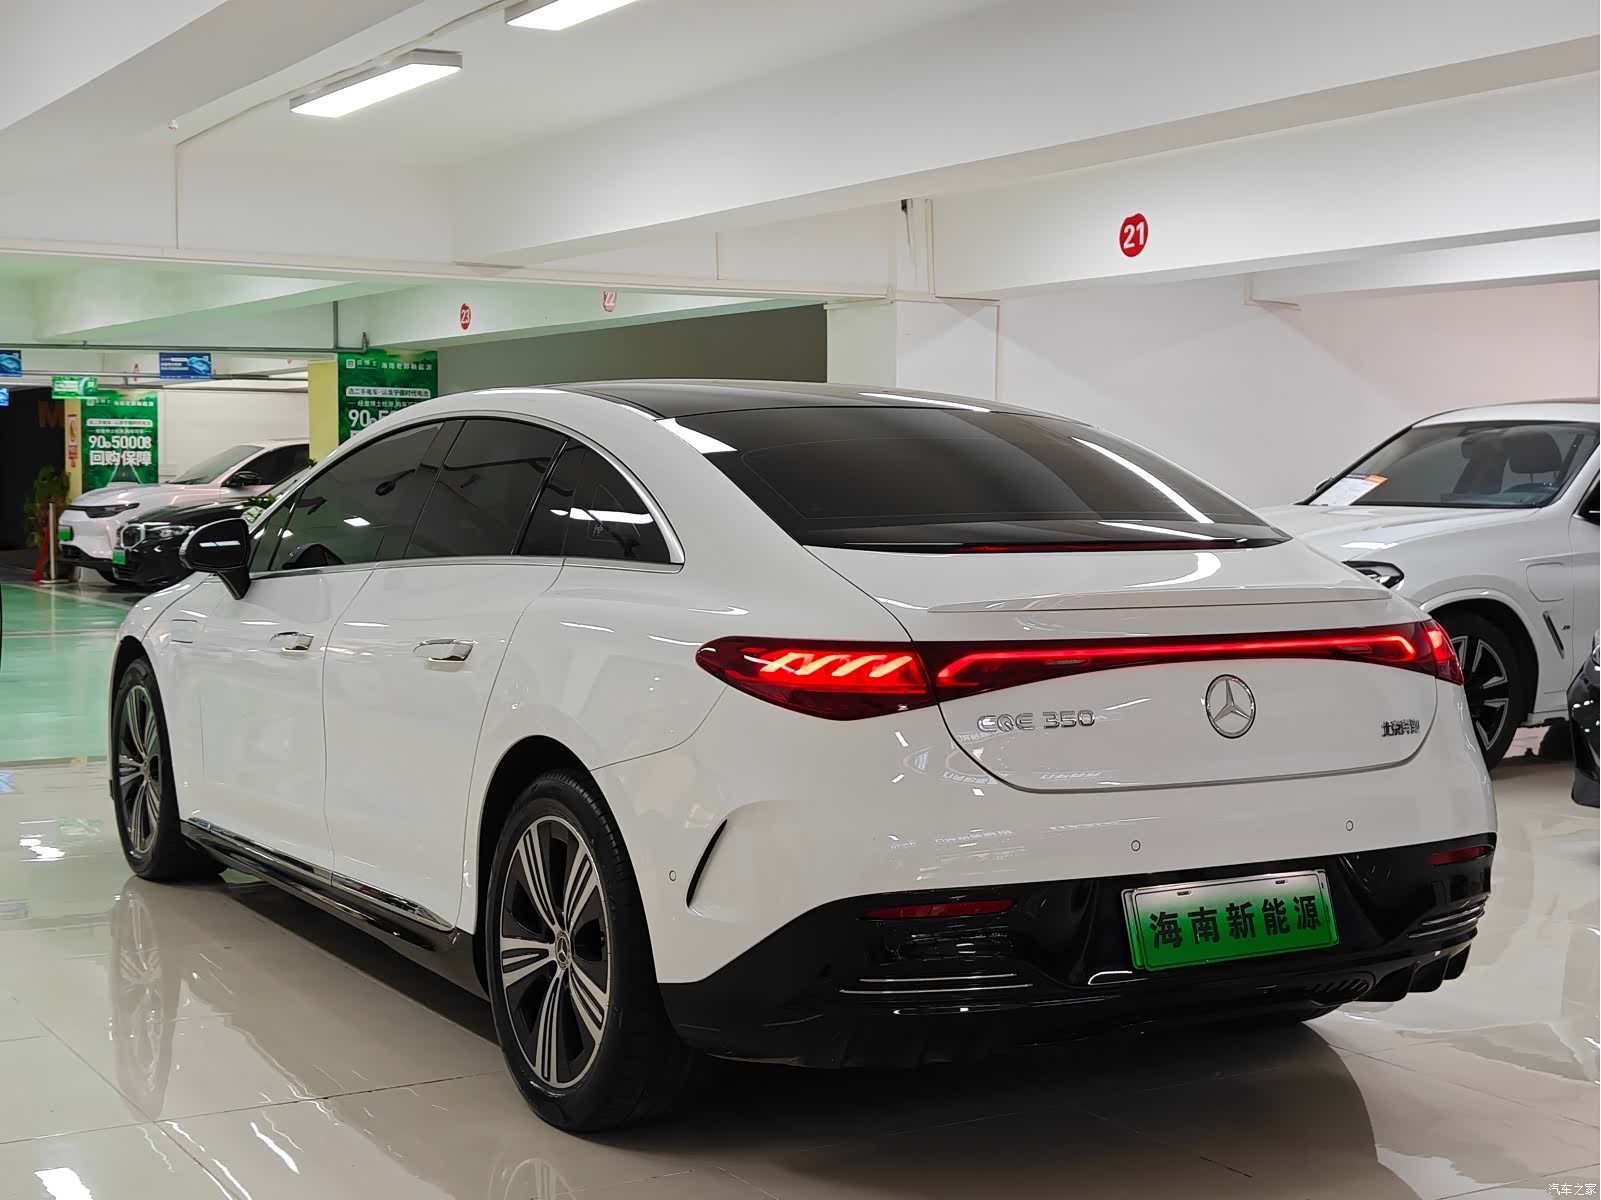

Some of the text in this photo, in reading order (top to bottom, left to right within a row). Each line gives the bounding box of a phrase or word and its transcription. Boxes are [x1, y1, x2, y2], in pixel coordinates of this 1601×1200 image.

[1123, 221, 1145, 249] 21
[605, 290, 616, 306] 22
[460, 308, 471, 324] 23
[89, 450, 152, 467] 回购保障
[977, 709, 1095, 732] EQE 350
[1150, 895, 1322, 949] 海南新能源
